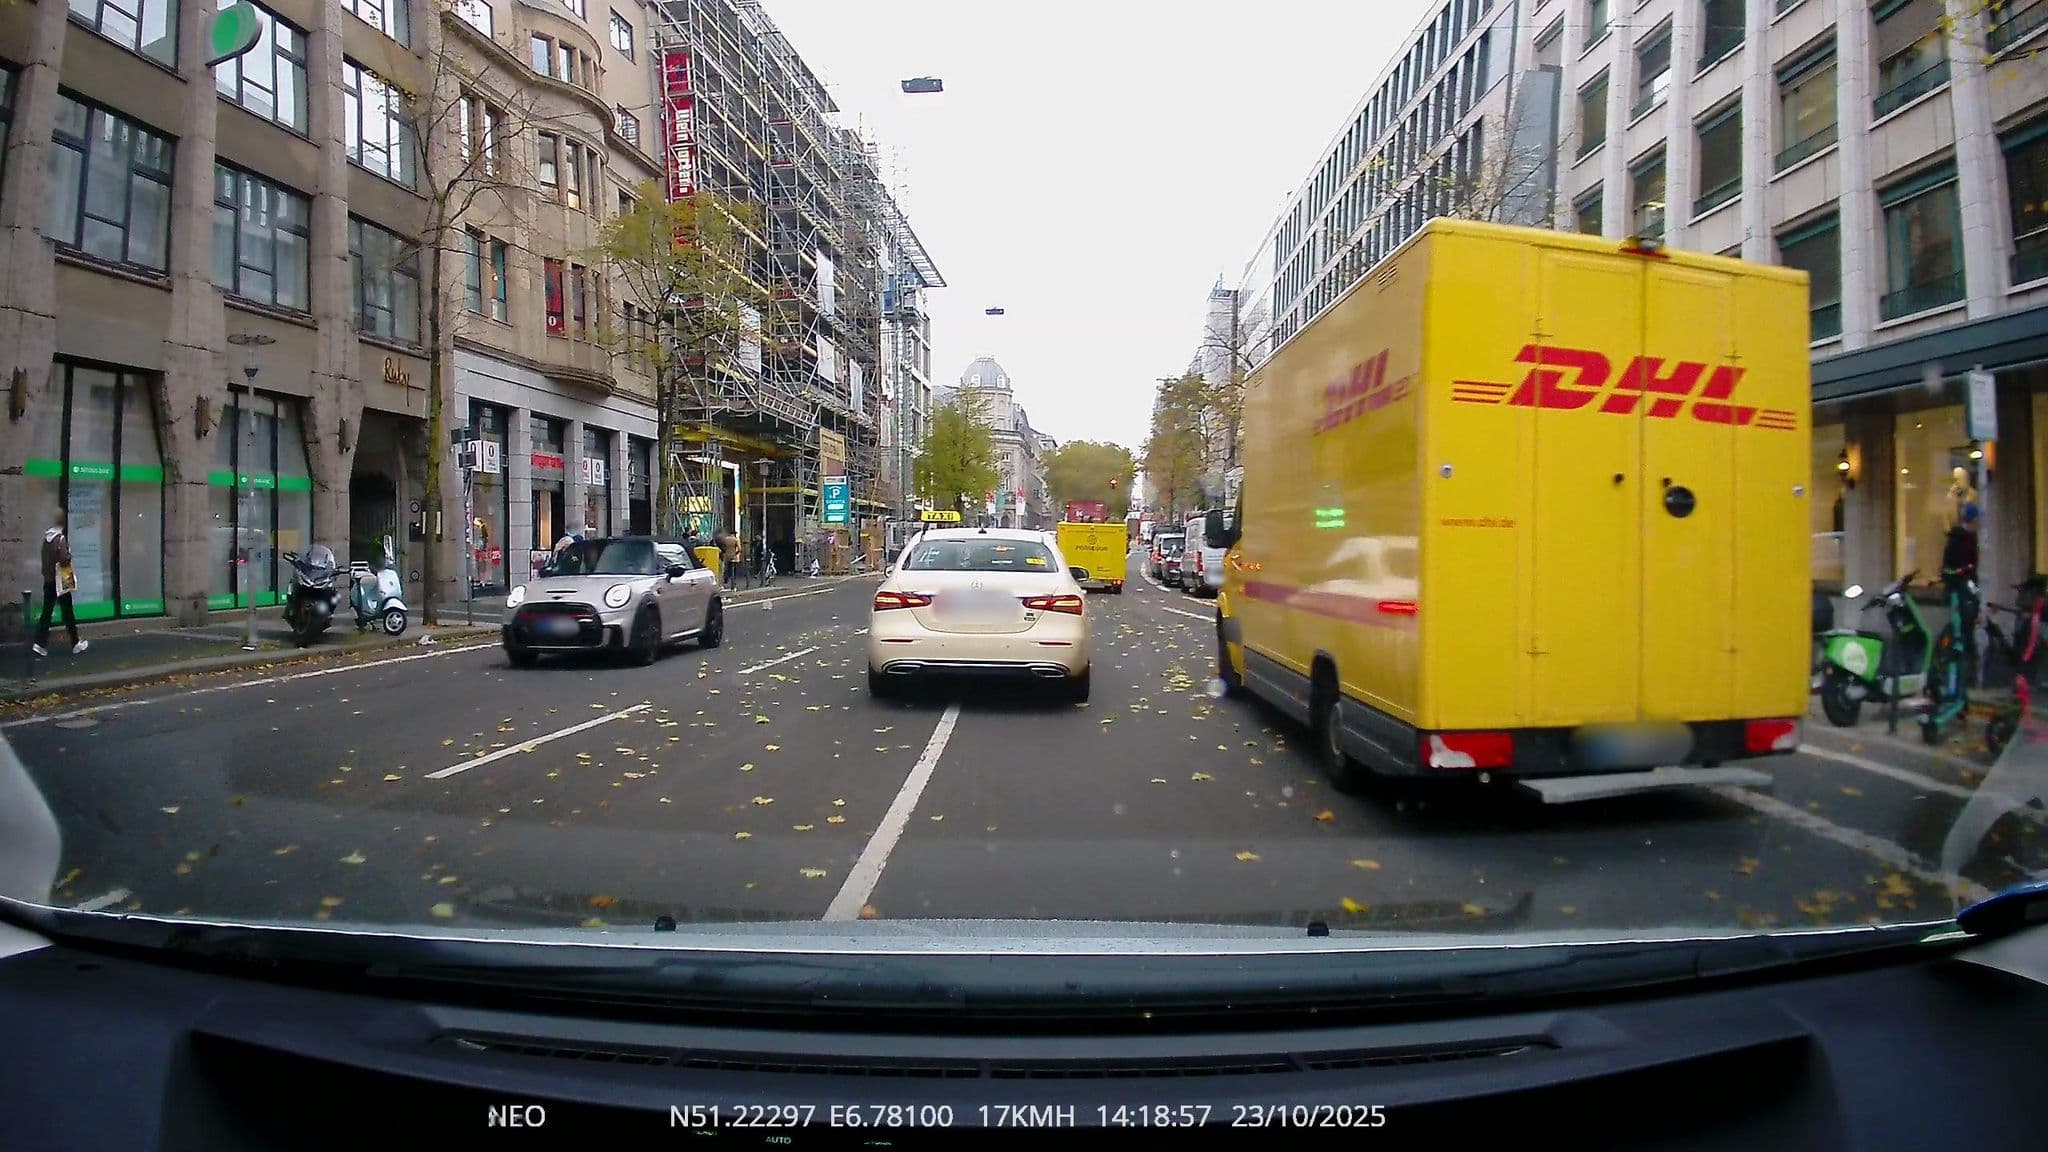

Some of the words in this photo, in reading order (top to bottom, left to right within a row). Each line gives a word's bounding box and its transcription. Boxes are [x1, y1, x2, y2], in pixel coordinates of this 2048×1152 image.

[384, 357, 411, 404] Ruby
[1507, 344, 1761, 427] DHL
[766, 1136, 792, 1145] AUTO
